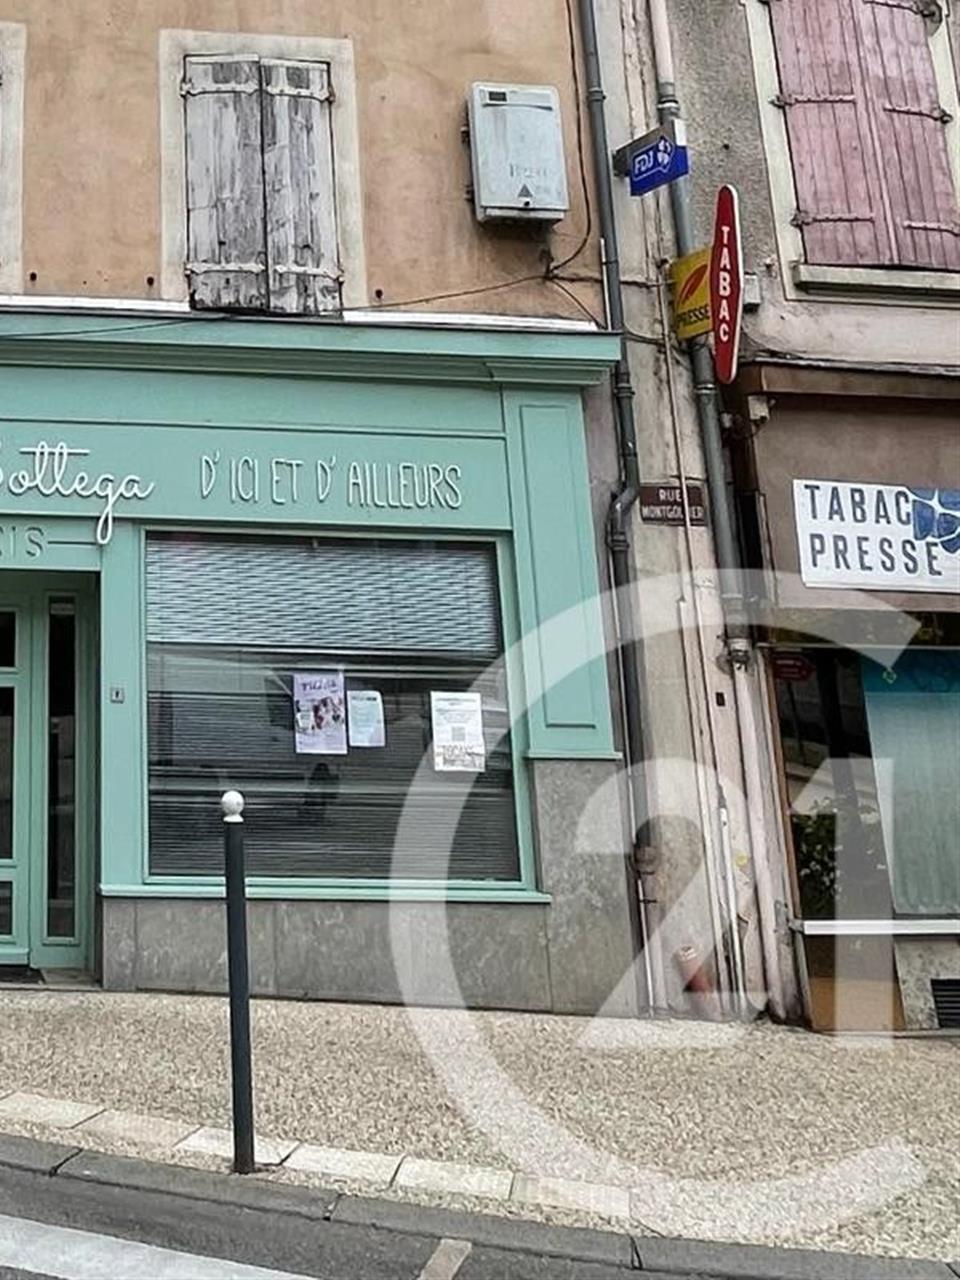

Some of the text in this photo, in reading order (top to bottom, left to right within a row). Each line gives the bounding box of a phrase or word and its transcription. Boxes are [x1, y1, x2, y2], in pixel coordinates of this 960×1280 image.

[634, 150, 654, 174] FDJ
[719, 225, 731, 343] TABAC
[658, 488, 683, 502] RUE
[803, 484, 912, 526] TABAC
[809, 533, 943, 577] PRESSE
